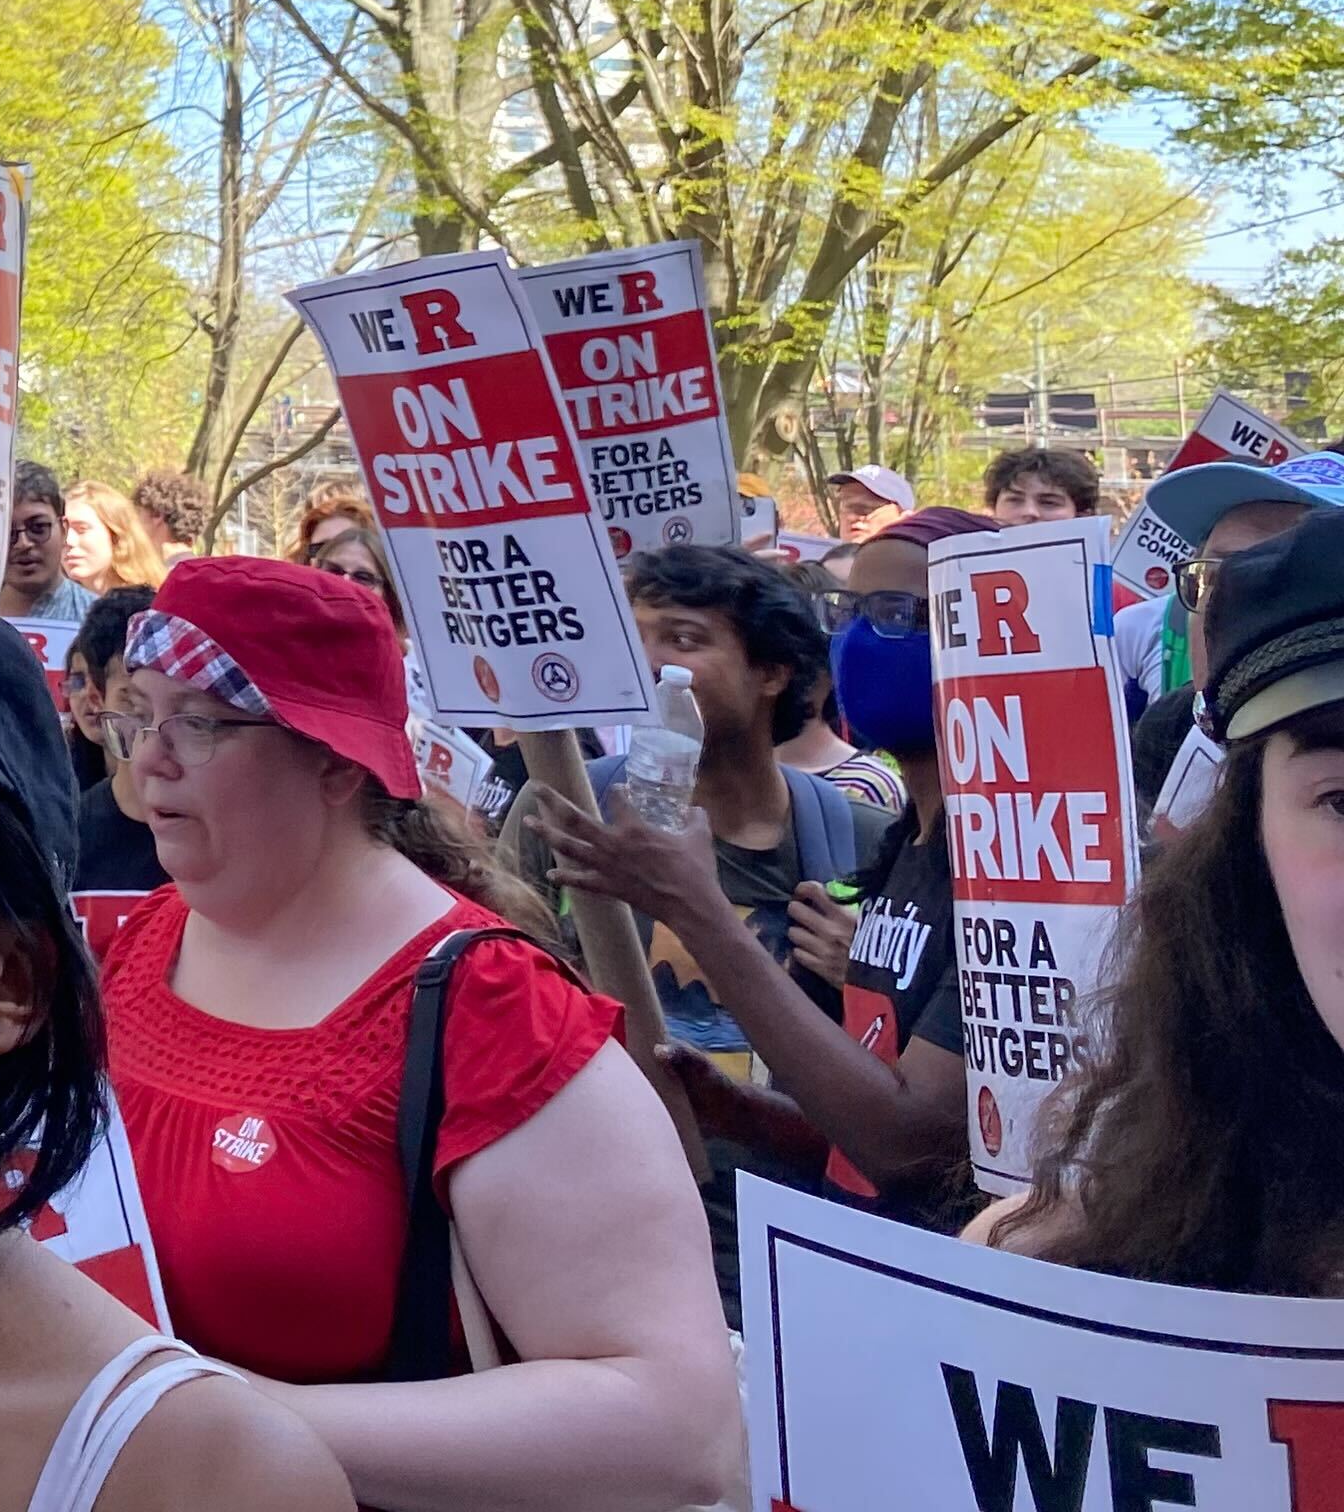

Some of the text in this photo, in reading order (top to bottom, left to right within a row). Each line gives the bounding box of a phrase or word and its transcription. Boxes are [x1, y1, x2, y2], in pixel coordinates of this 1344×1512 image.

[553, 269, 663, 318] WE R
[349, 288, 477, 356] WE R
[580, 330, 658, 383] ON
[392, 377, 482, 449] ON
[562, 366, 712, 432] TRIKE
[591, 437, 675, 470] FOR A
[1228, 419, 1269, 457] WE
[372, 435, 575, 516] STRIKE
[597, 483, 703, 521] UTGERS
[436, 534, 531, 575] FOR A
[1136, 534, 1186, 566] COMM
[1139, 517, 1196, 557] STUDE
[438, 569, 561, 611] BETTER
[969, 569, 1042, 658] R
[443, 606, 586, 648] RUTGERS
[946, 695, 1030, 785] ON
[945, 791, 1112, 883] TRIKE
[962, 917, 1058, 971] FOR A
[961, 969, 1078, 1028] BETTER
[212, 1128, 270, 1164] STRIKE
[238, 1116, 265, 1139] ON
